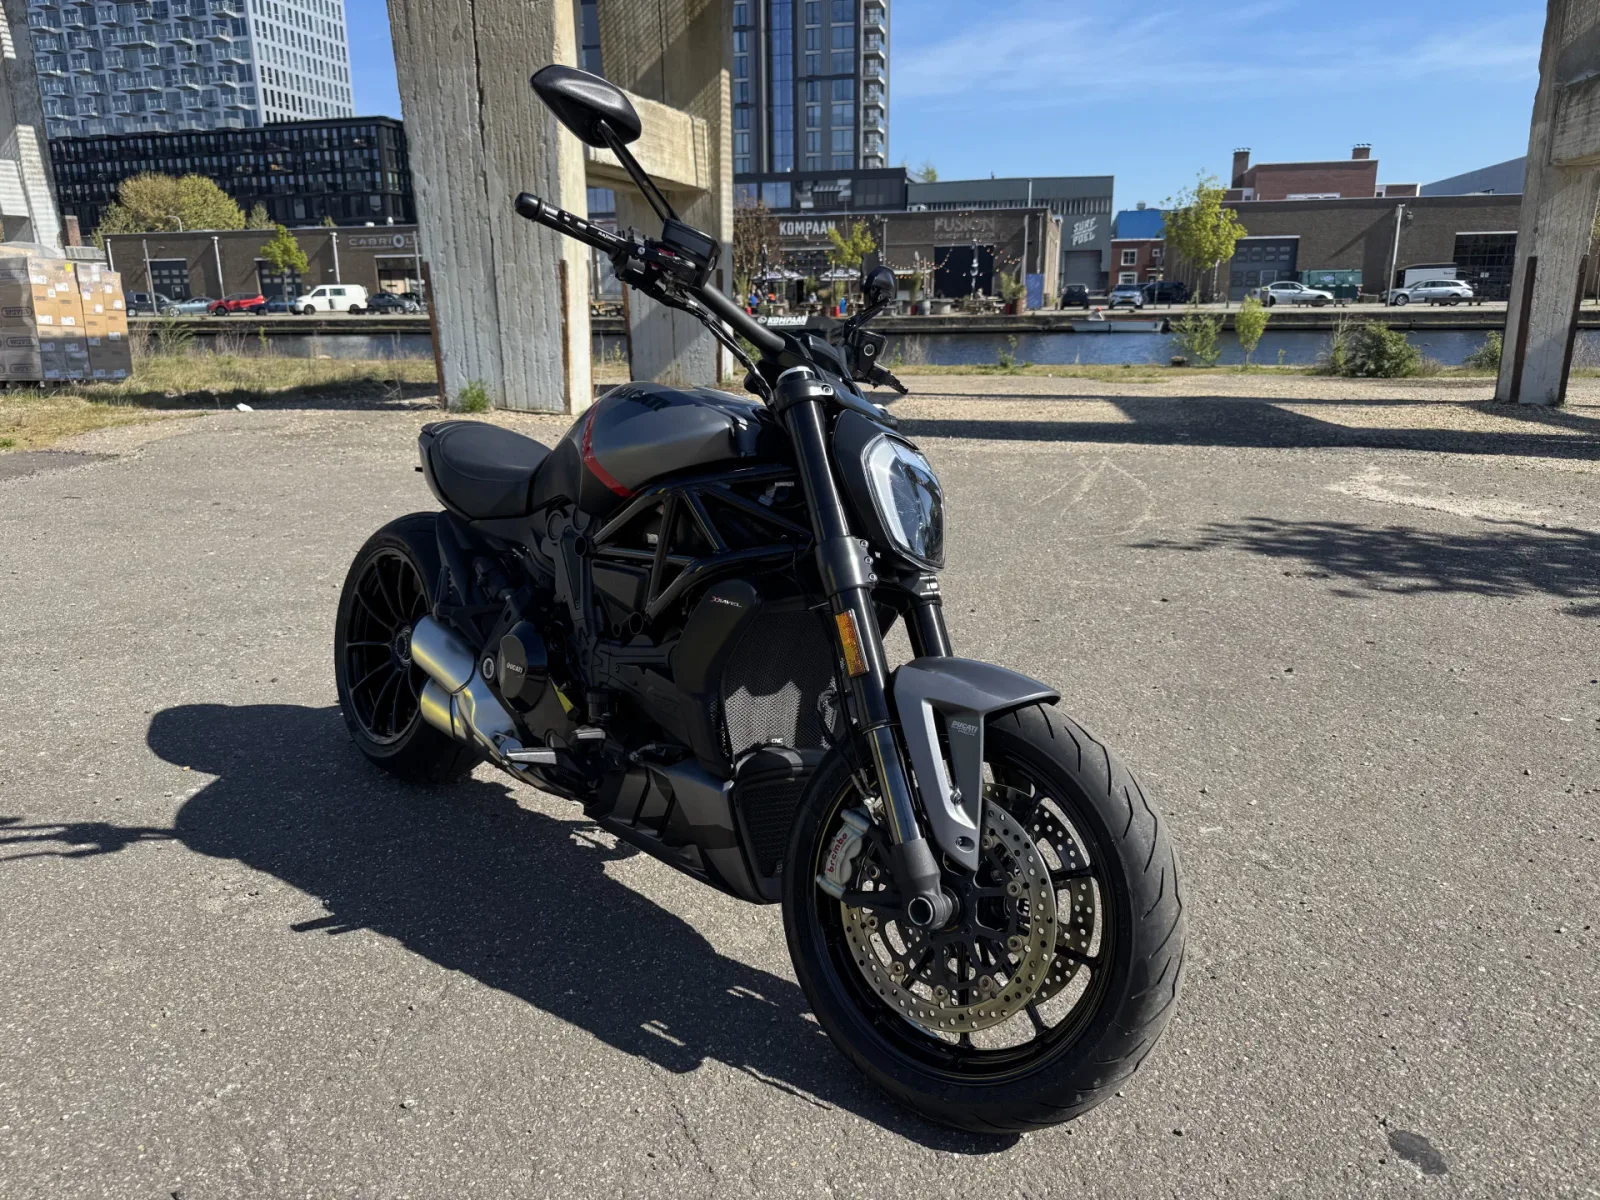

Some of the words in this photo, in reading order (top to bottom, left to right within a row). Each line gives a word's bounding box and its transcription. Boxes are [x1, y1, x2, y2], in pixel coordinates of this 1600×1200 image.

[779, 220, 836, 235] KOMPAAN
[934, 216, 996, 231] FUSION
[1073, 216, 1097, 232] SURF
[1072, 231, 1096, 246] POEL
[767, 316, 808, 326] KOMPAAN
[506, 662, 523, 673] DUCATI
[952, 720, 978, 733] DUCATI
[827, 833, 848, 873] brembo
